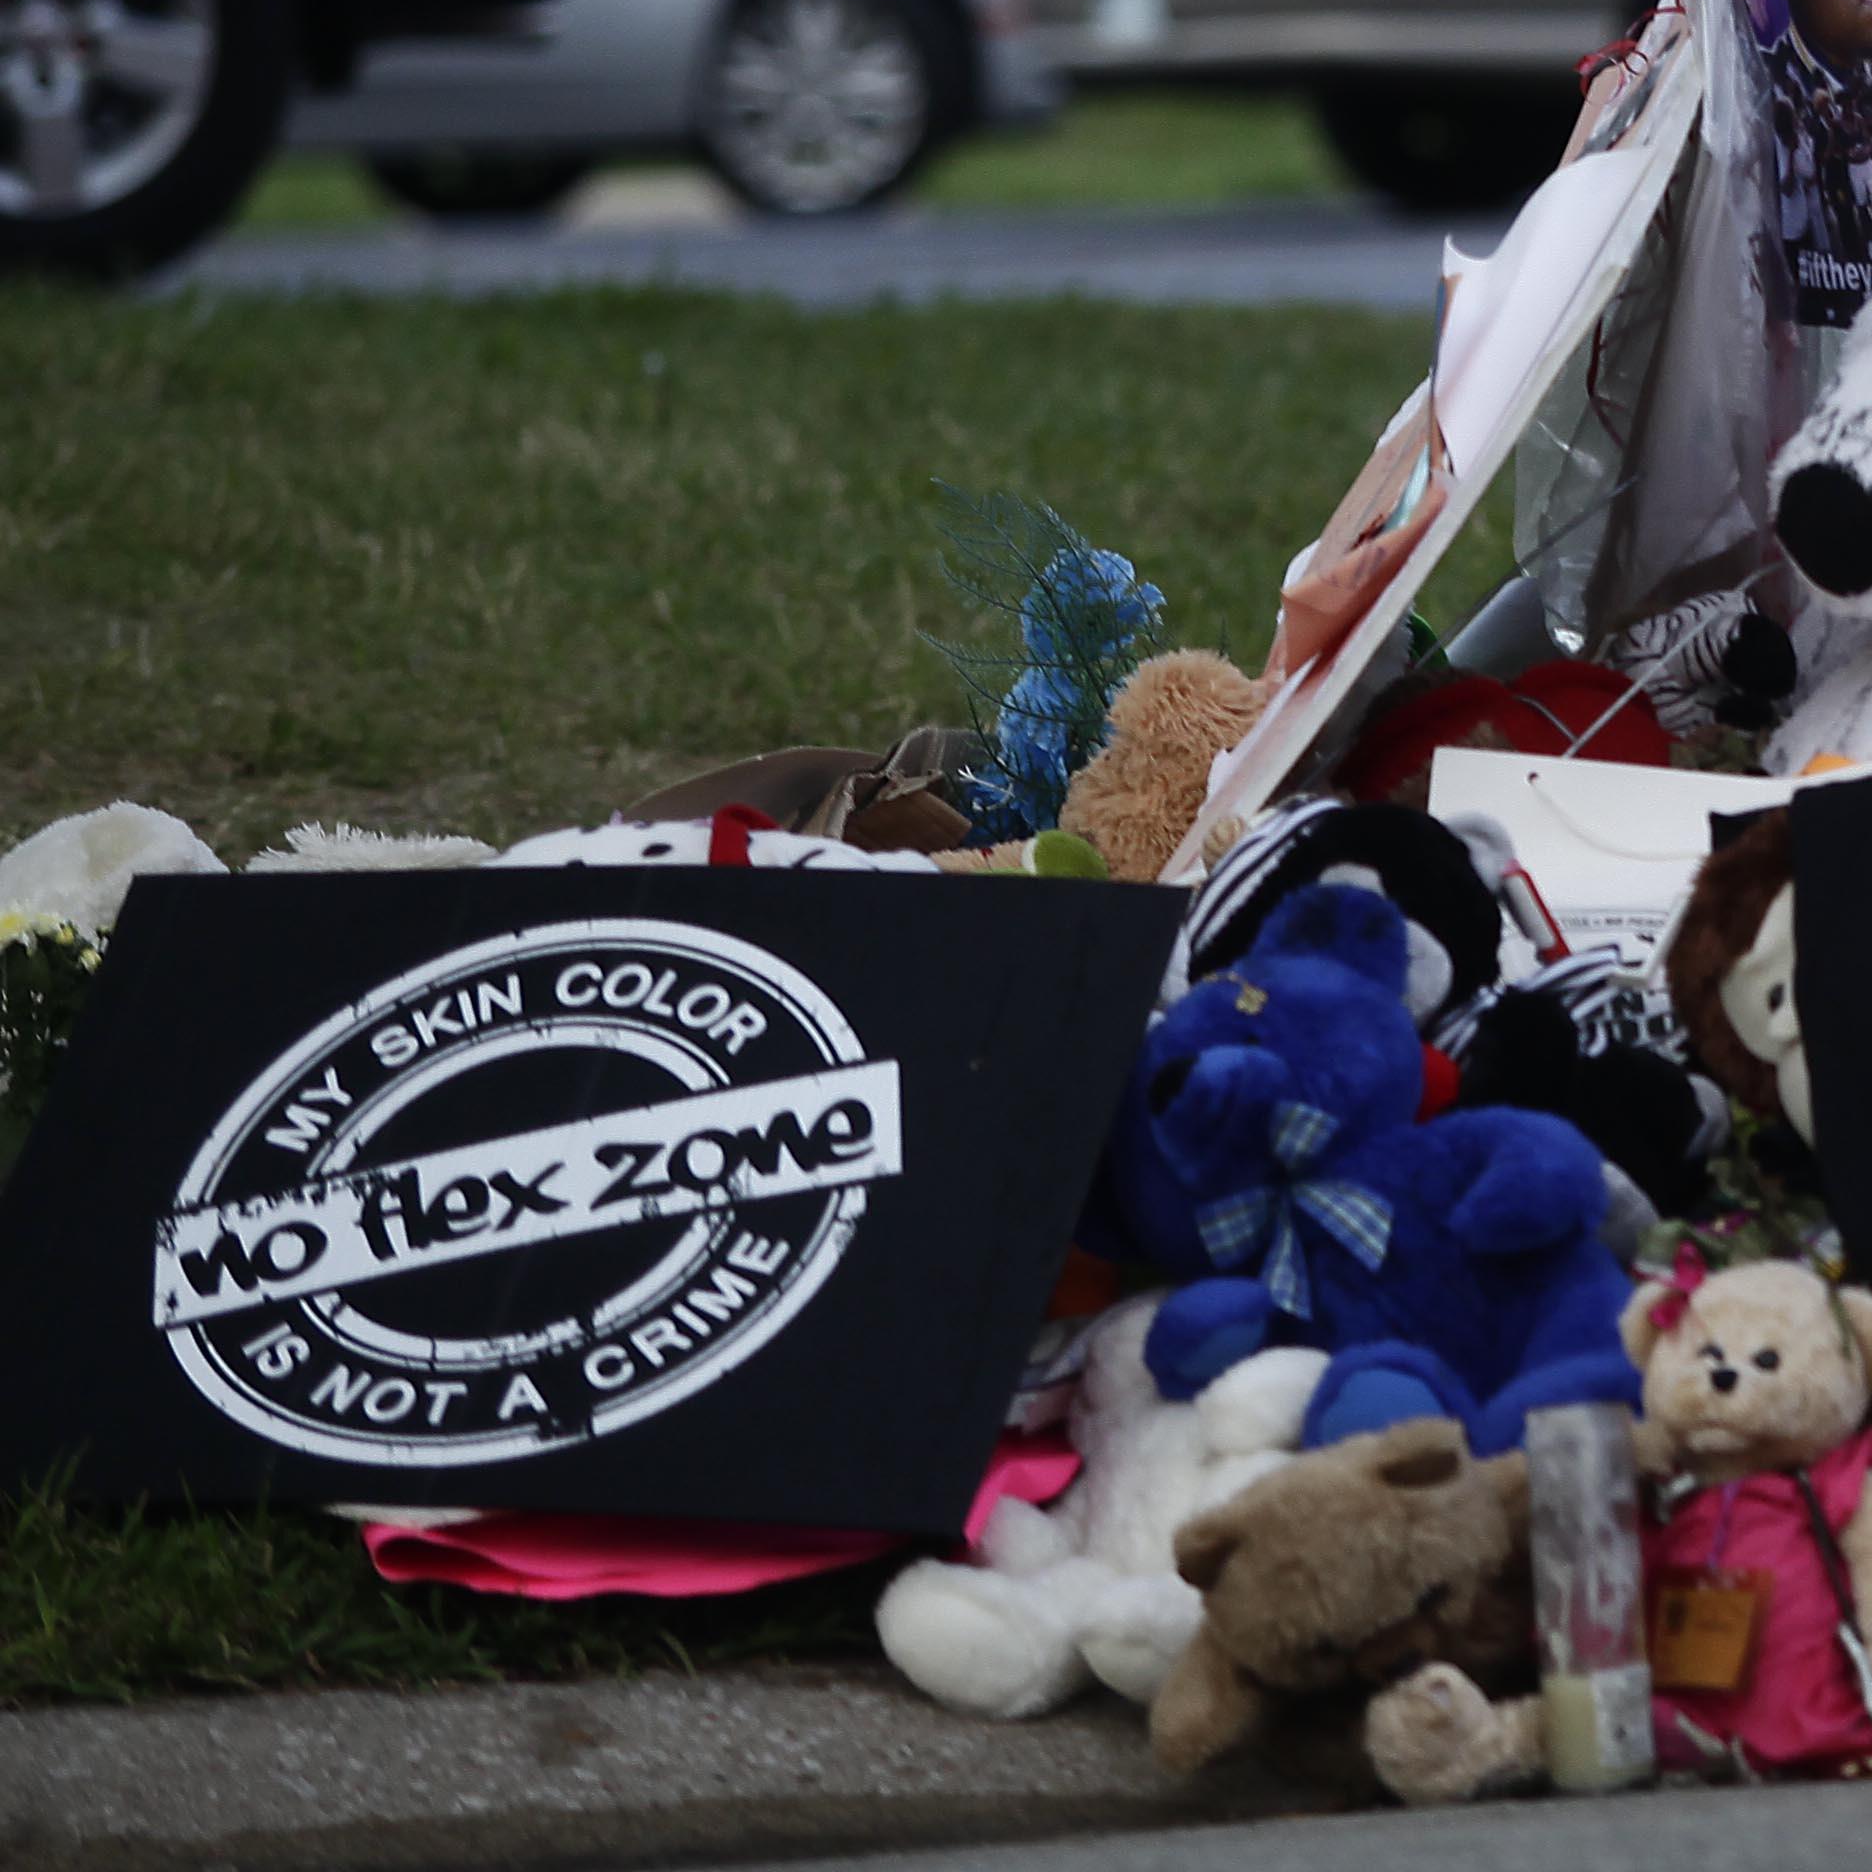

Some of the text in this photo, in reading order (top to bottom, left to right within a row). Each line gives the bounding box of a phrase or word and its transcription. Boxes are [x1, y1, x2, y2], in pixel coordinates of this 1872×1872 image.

[264, 961, 770, 1154] MY SKIN COLOR
[243, 1231, 791, 1427] IS NOT A CRIME
